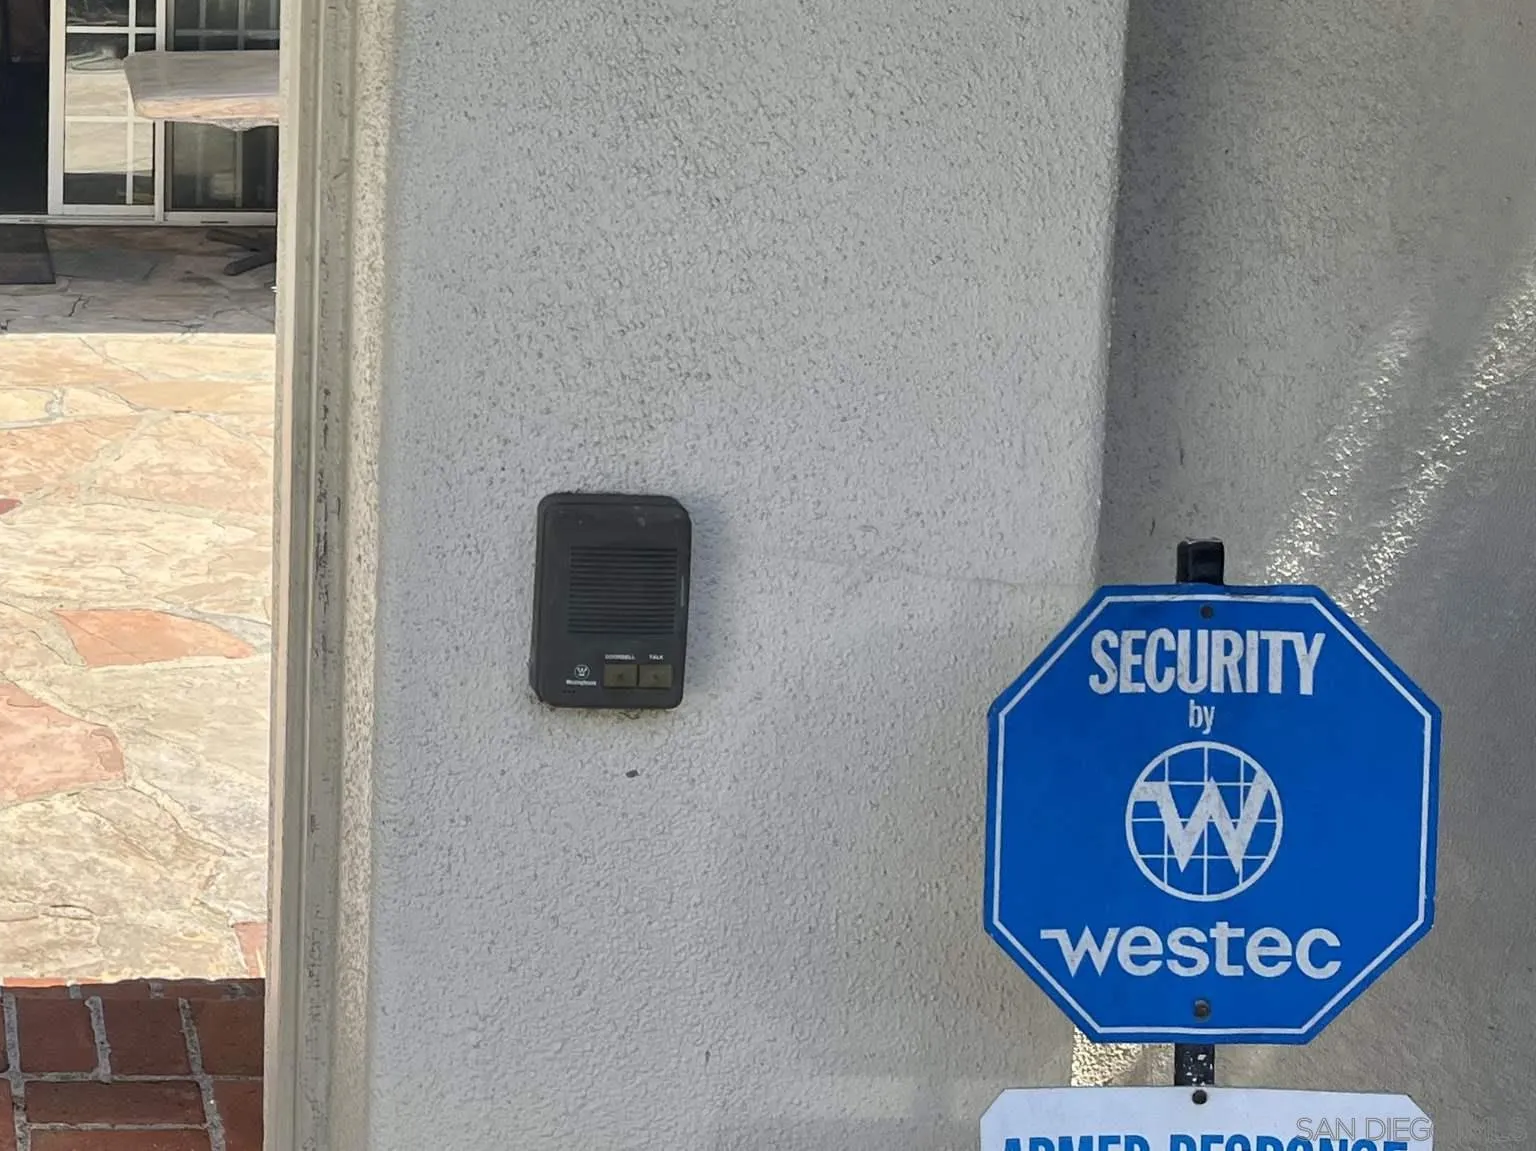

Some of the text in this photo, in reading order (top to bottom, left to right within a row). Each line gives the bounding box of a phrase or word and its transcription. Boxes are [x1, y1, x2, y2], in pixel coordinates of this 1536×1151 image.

[1088, 627, 1326, 696] SECURITY
[1188, 699, 1215, 734] by
[1040, 921, 1342, 980] westec
